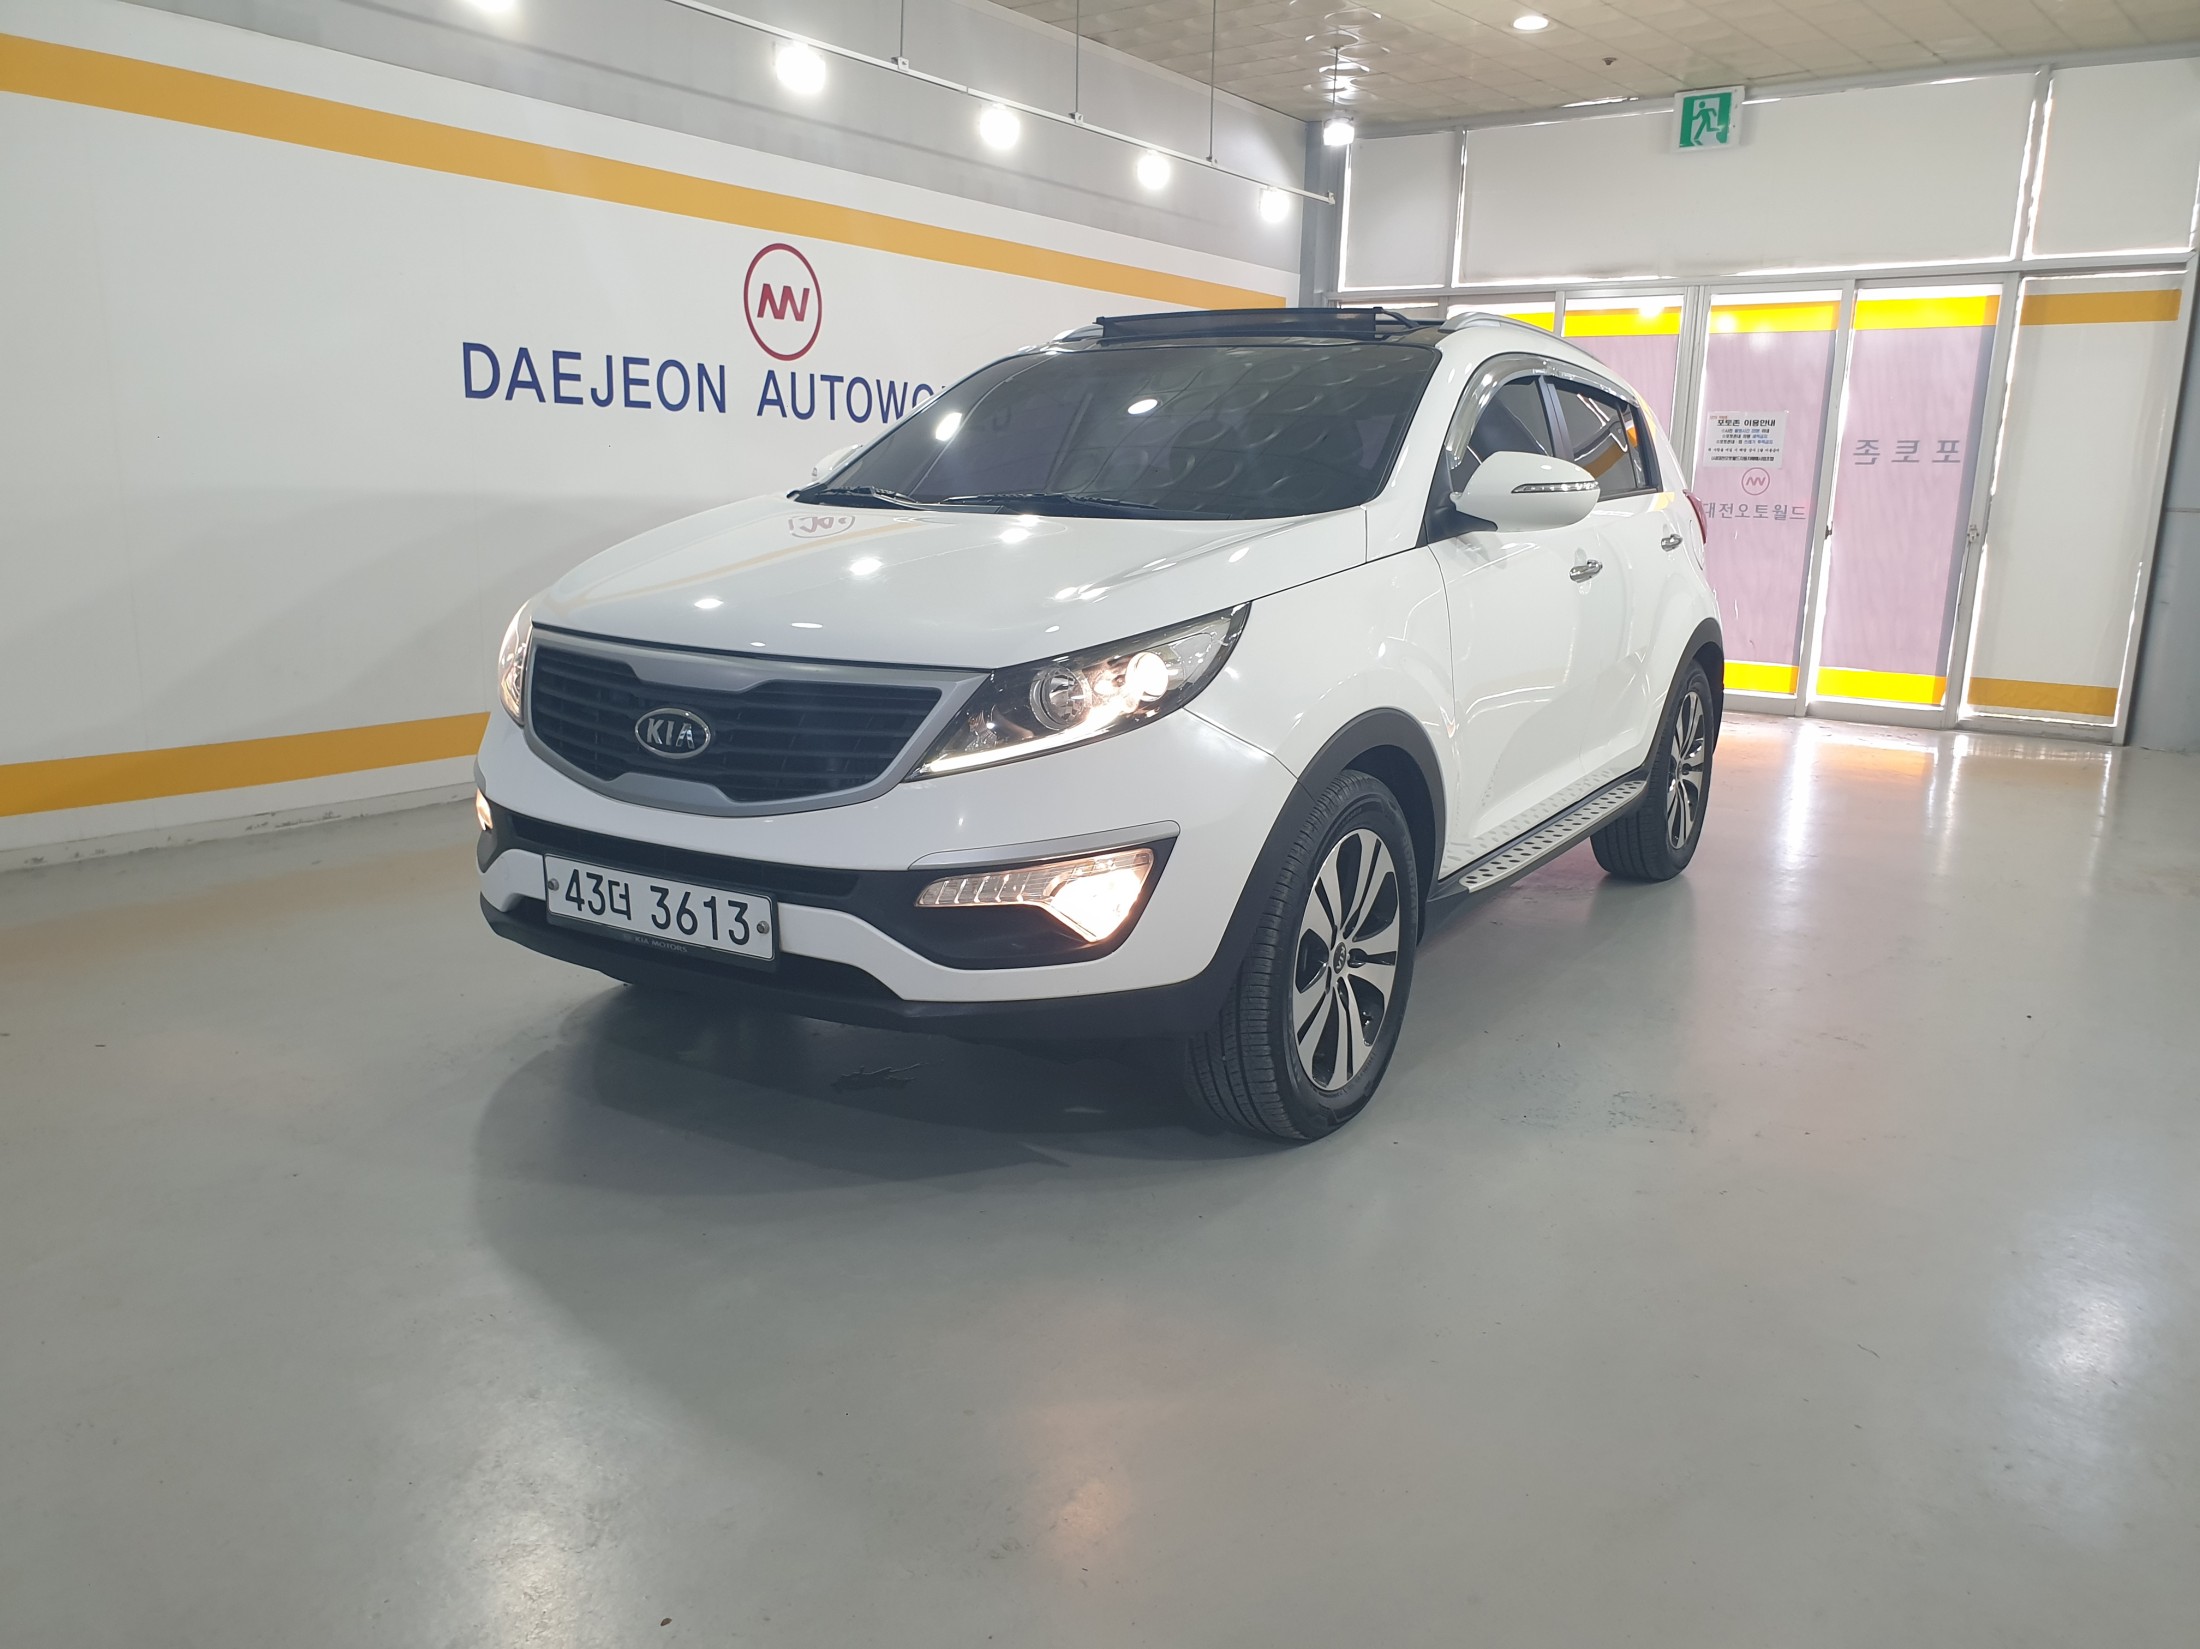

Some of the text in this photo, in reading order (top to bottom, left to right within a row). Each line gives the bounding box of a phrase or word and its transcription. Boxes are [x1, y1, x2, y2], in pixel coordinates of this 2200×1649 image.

[462, 341, 727, 414] DAEJEON
[1703, 502, 1807, 520] 대전오토월드
[646, 717, 695, 749] KIA
[564, 868, 751, 946] 43더 3613
[634, 936, 688, 953] KIA MOTORS
